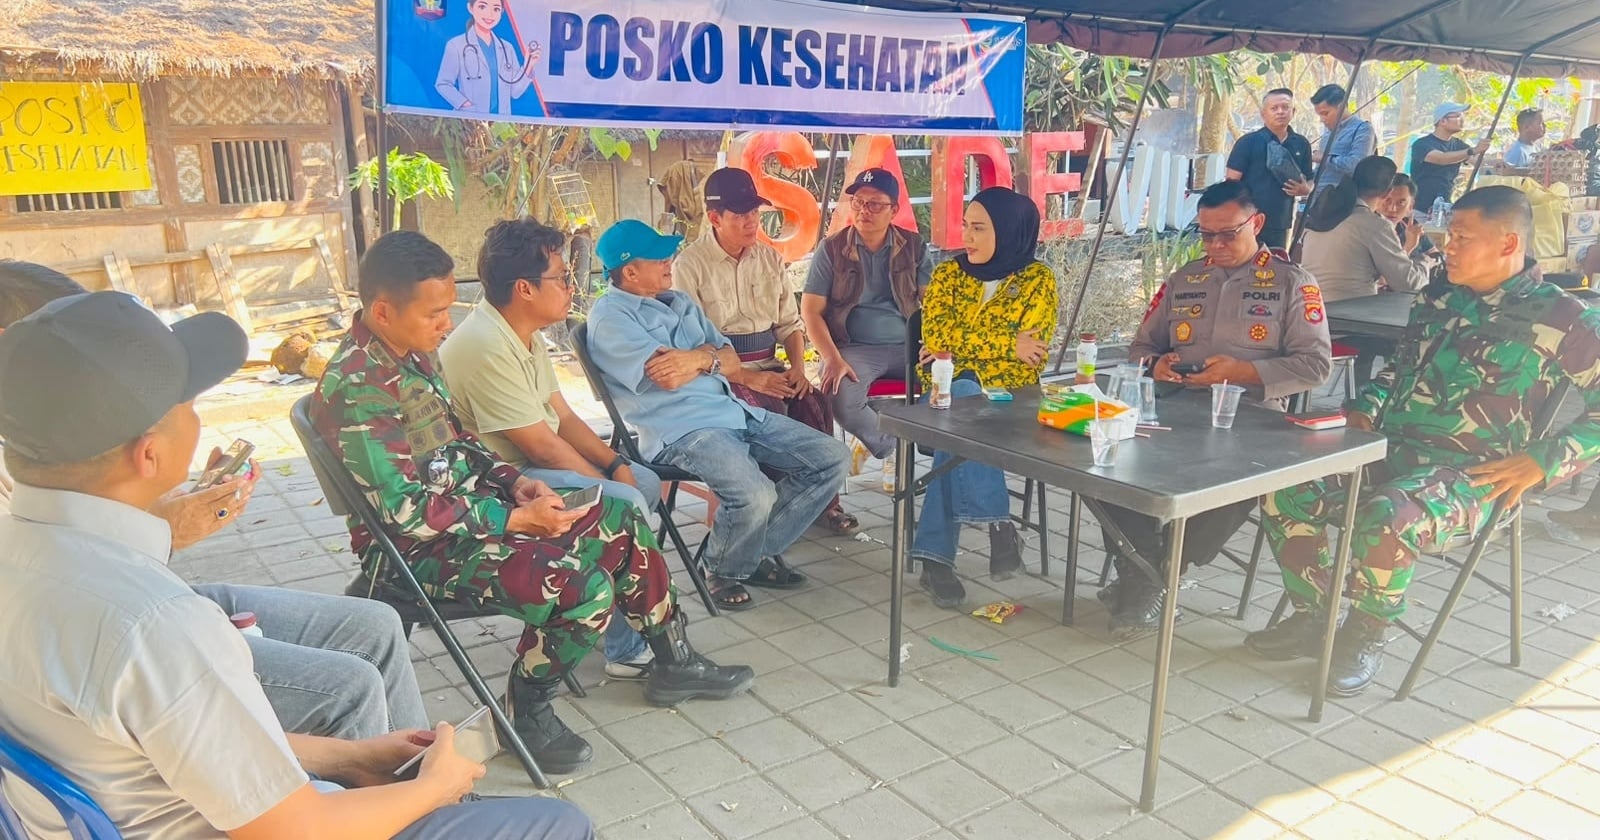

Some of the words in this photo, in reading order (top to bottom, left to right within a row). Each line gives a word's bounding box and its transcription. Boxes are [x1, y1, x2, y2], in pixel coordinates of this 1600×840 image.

[548, 11, 723, 84] POSKO
[738, 25, 968, 95] KESEHATAN
[0, 96, 136, 136] POSKO
[0, 143, 138, 173] ESEHATAN
[728, 131, 1085, 262] SADE
[1242, 291, 1280, 301] POLRI
